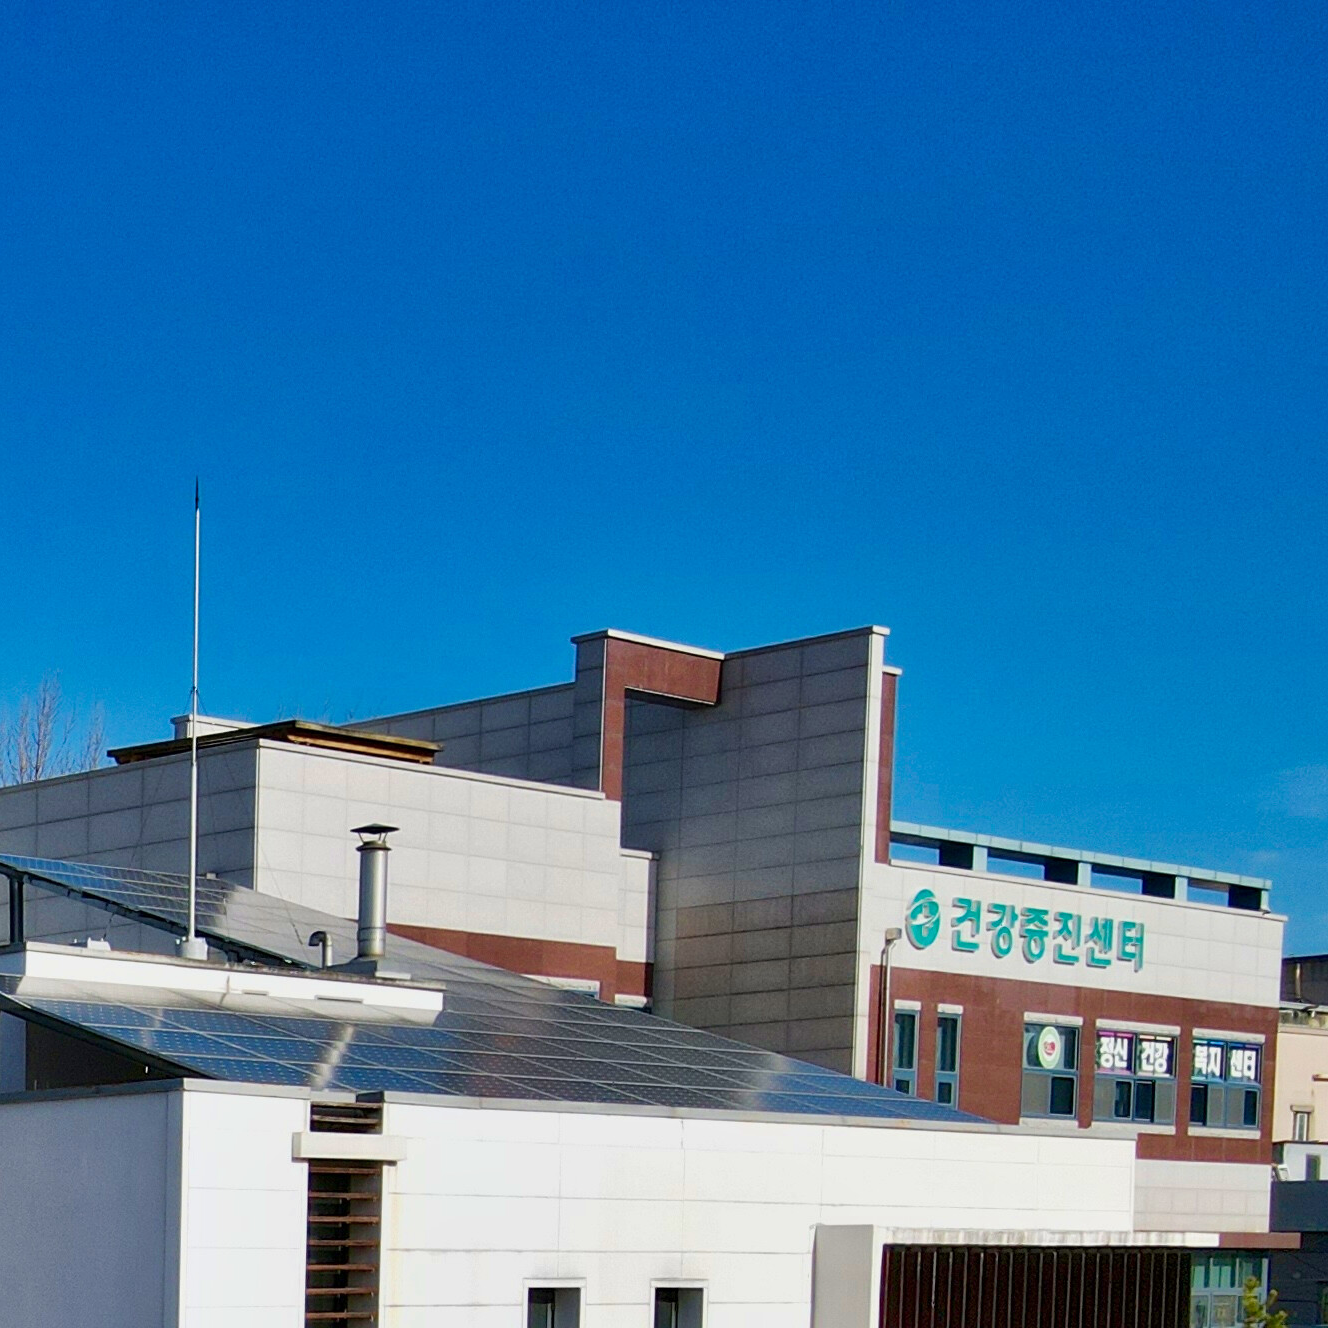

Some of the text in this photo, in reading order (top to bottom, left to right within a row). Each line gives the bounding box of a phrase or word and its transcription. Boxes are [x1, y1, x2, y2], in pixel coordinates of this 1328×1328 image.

[951, 897, 1145, 972] 건강증진센터
[1100, 1036, 1257, 1080] 정신 건강 복지 센터
